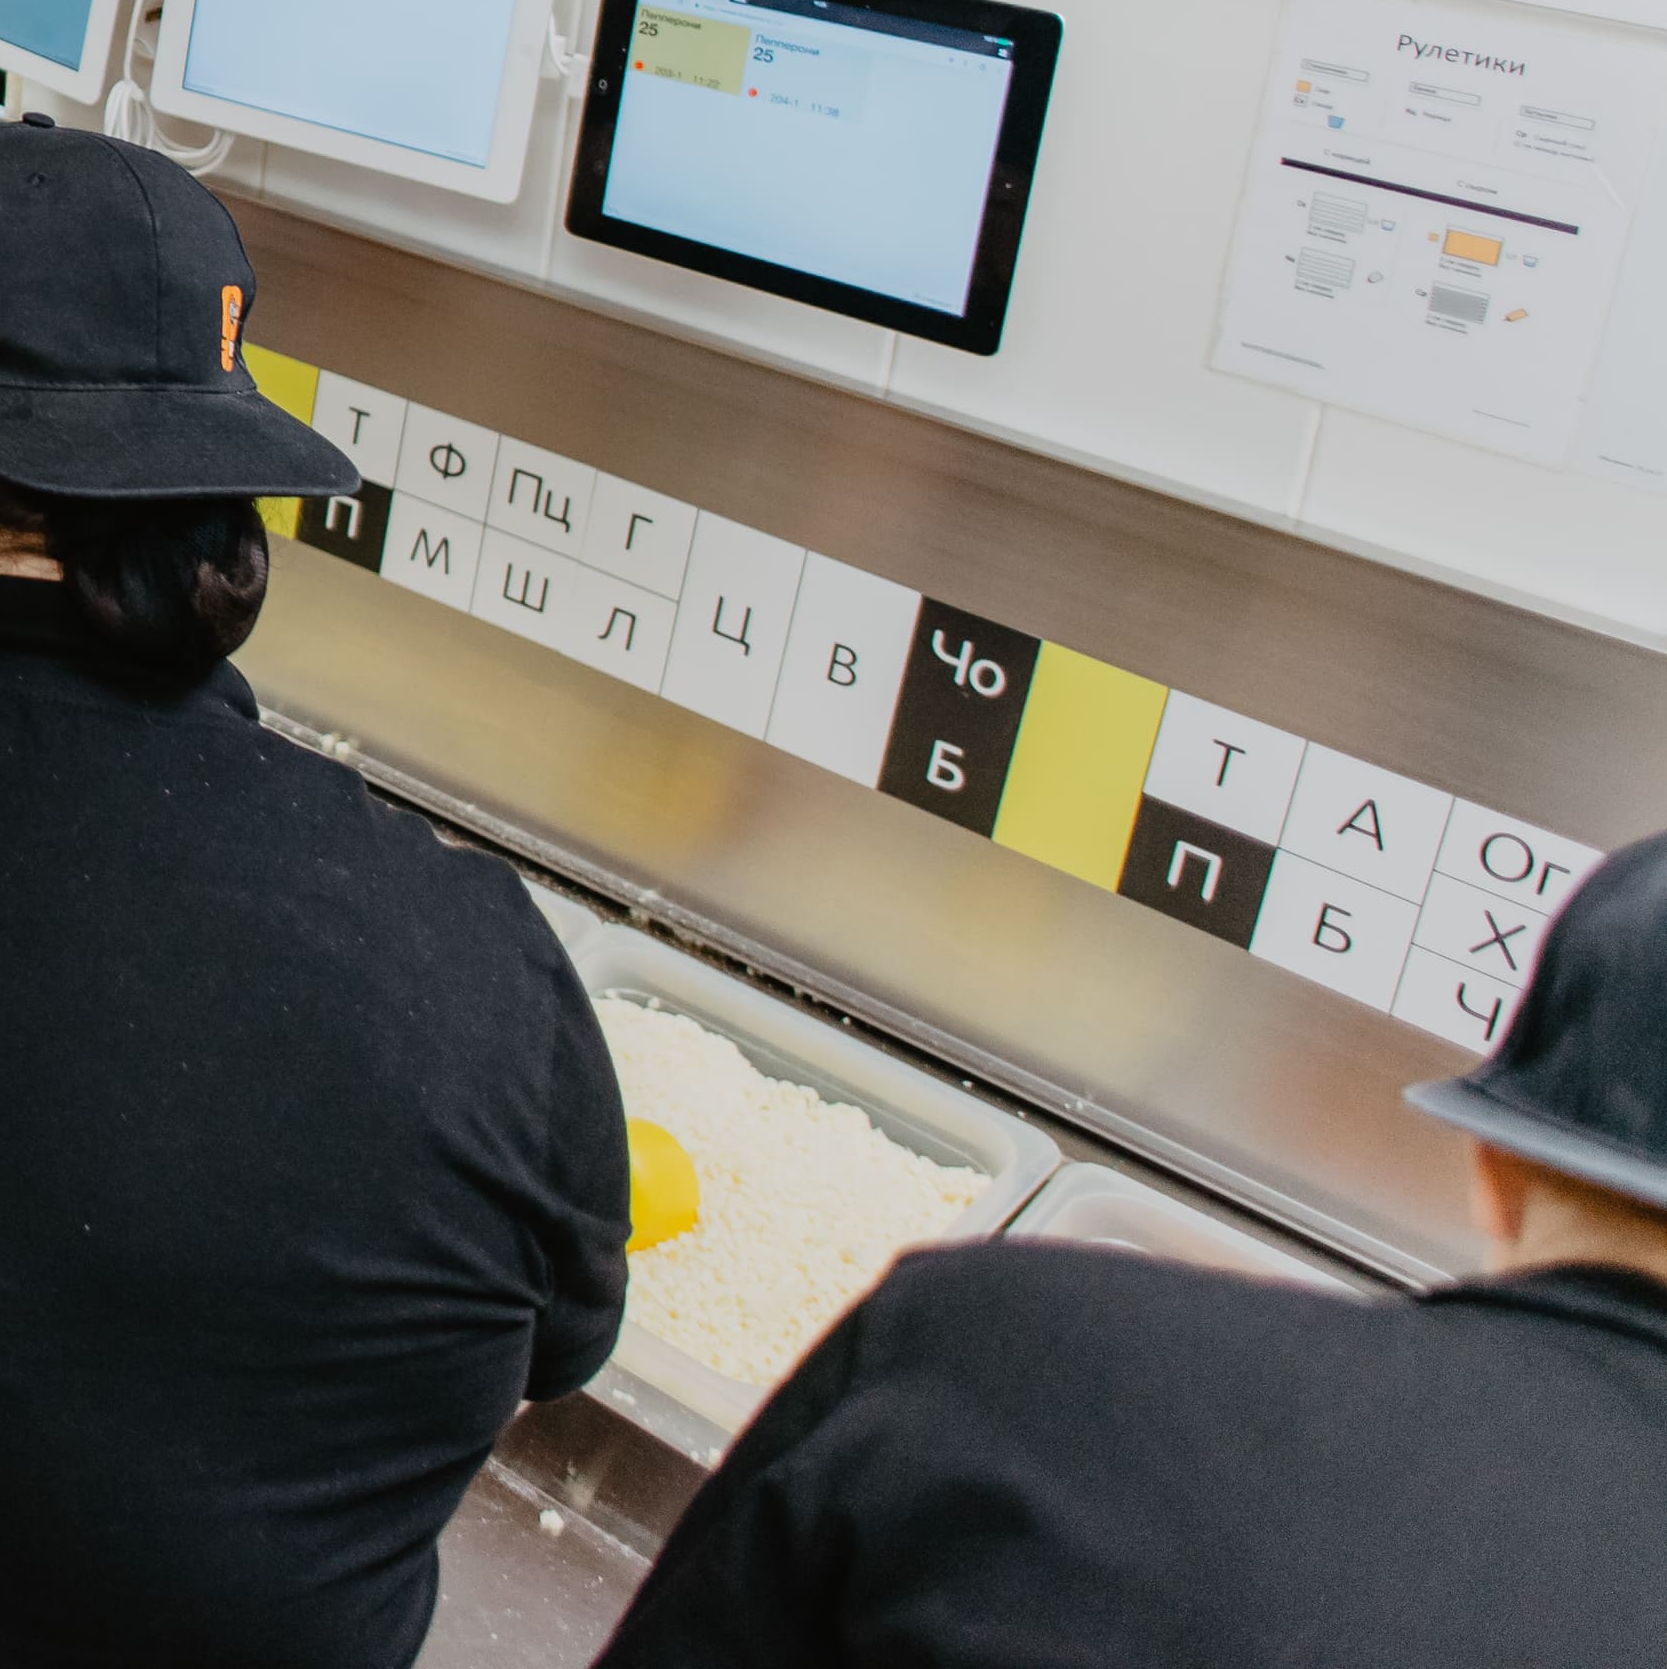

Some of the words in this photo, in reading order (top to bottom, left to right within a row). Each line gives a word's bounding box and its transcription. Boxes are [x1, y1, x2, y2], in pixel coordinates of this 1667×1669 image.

[638, 21, 659, 37] 25
[753, 47, 774, 64] 25
[1396, 34, 1526, 76] Рулетики
[348, 406, 371, 445] Т
[429, 442, 467, 480] Ф
[508, 467, 572, 534] Пц
[625, 513, 654, 551] Г
[324, 494, 363, 540] П
[410, 528, 450, 575] М
[502, 562, 550, 614] Ш
[597, 606, 637, 652] Л
[712, 595, 752, 657] Ц
[827, 642, 858, 687] В
[931, 629, 1007, 698] Чо
[926, 739, 966, 792] Б
[1213, 739, 1246, 787] Т
[1336, 799, 1384, 852] А
[1479, 832, 1571, 896] Ог
[1166, 840, 1223, 903] П
[1312, 902, 1352, 954] Б
[1469, 909, 1527, 972] Х
[1456, 980, 1502, 1043] Ч
